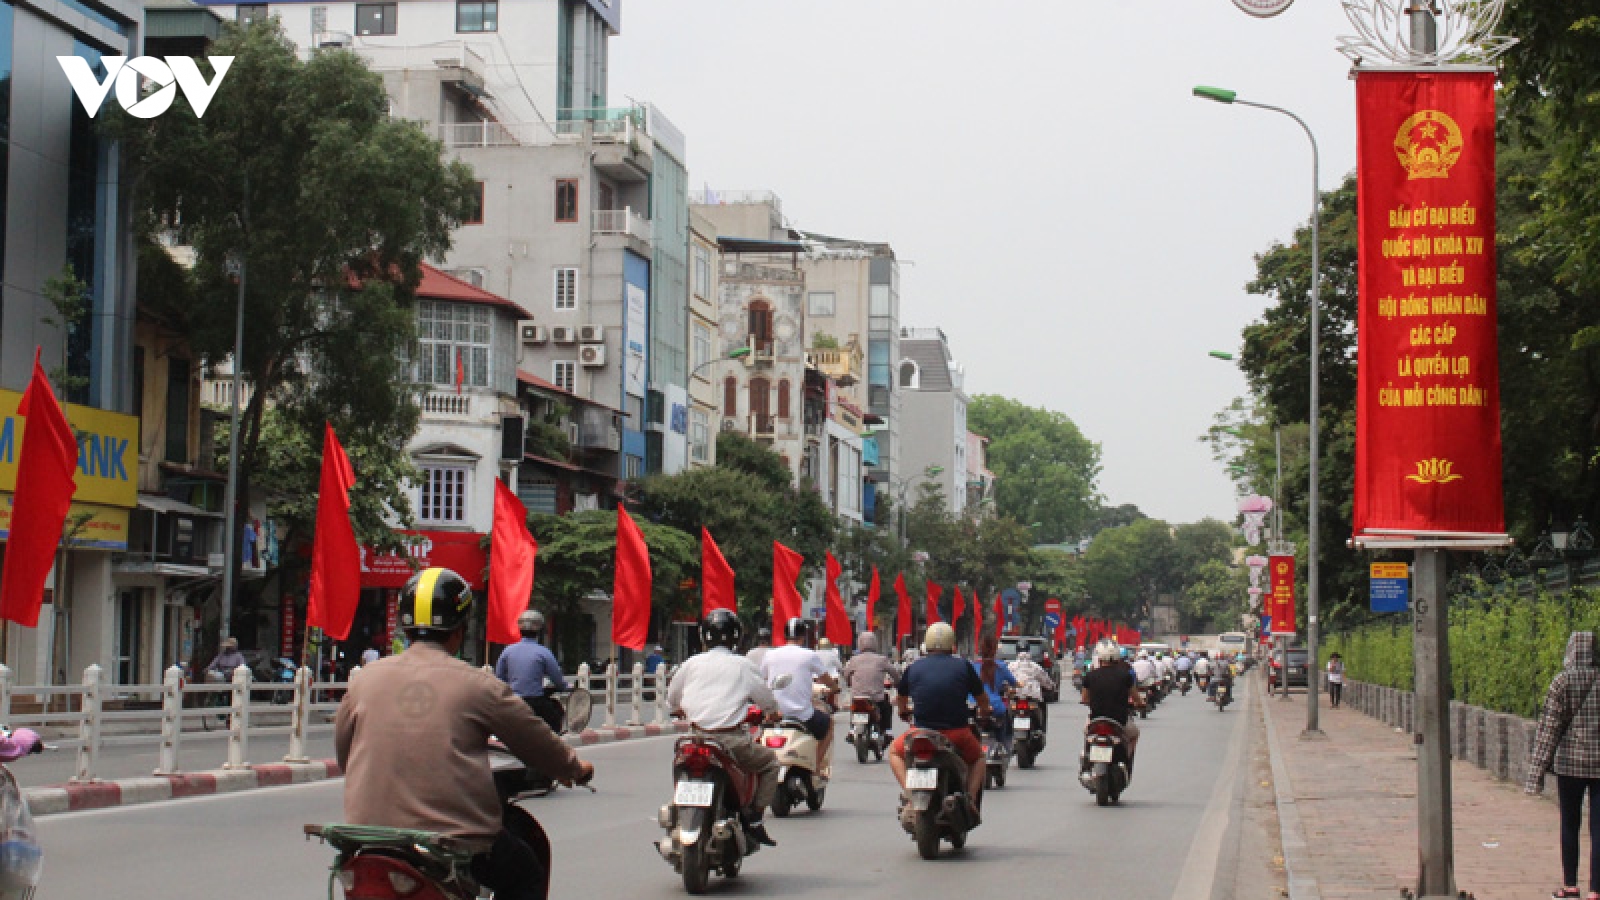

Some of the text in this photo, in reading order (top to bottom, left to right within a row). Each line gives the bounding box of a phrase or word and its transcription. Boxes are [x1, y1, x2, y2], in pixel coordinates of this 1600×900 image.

[1429, 207, 1449, 229] ĐẠI
[1450, 200, 1476, 225] BIỂU
[1382, 233, 1411, 259] QUỐC
[1413, 233, 1431, 260] HỘI
[1465, 236, 1484, 255] XIV
[1402, 259, 1465, 289] VÀ ĐẠI BIỂU
[1378, 292, 1487, 320] HỘI ĐỒNG NHÂN DÂN
[1410, 320, 1457, 346] CÁC CẤP
[1398, 350, 1470, 379] LÀ QUYỀN LỢI
[1379, 381, 1401, 407] CỦA
[1426, 384, 1457, 407] CÔNG
[77, 433, 129, 481] ANK
